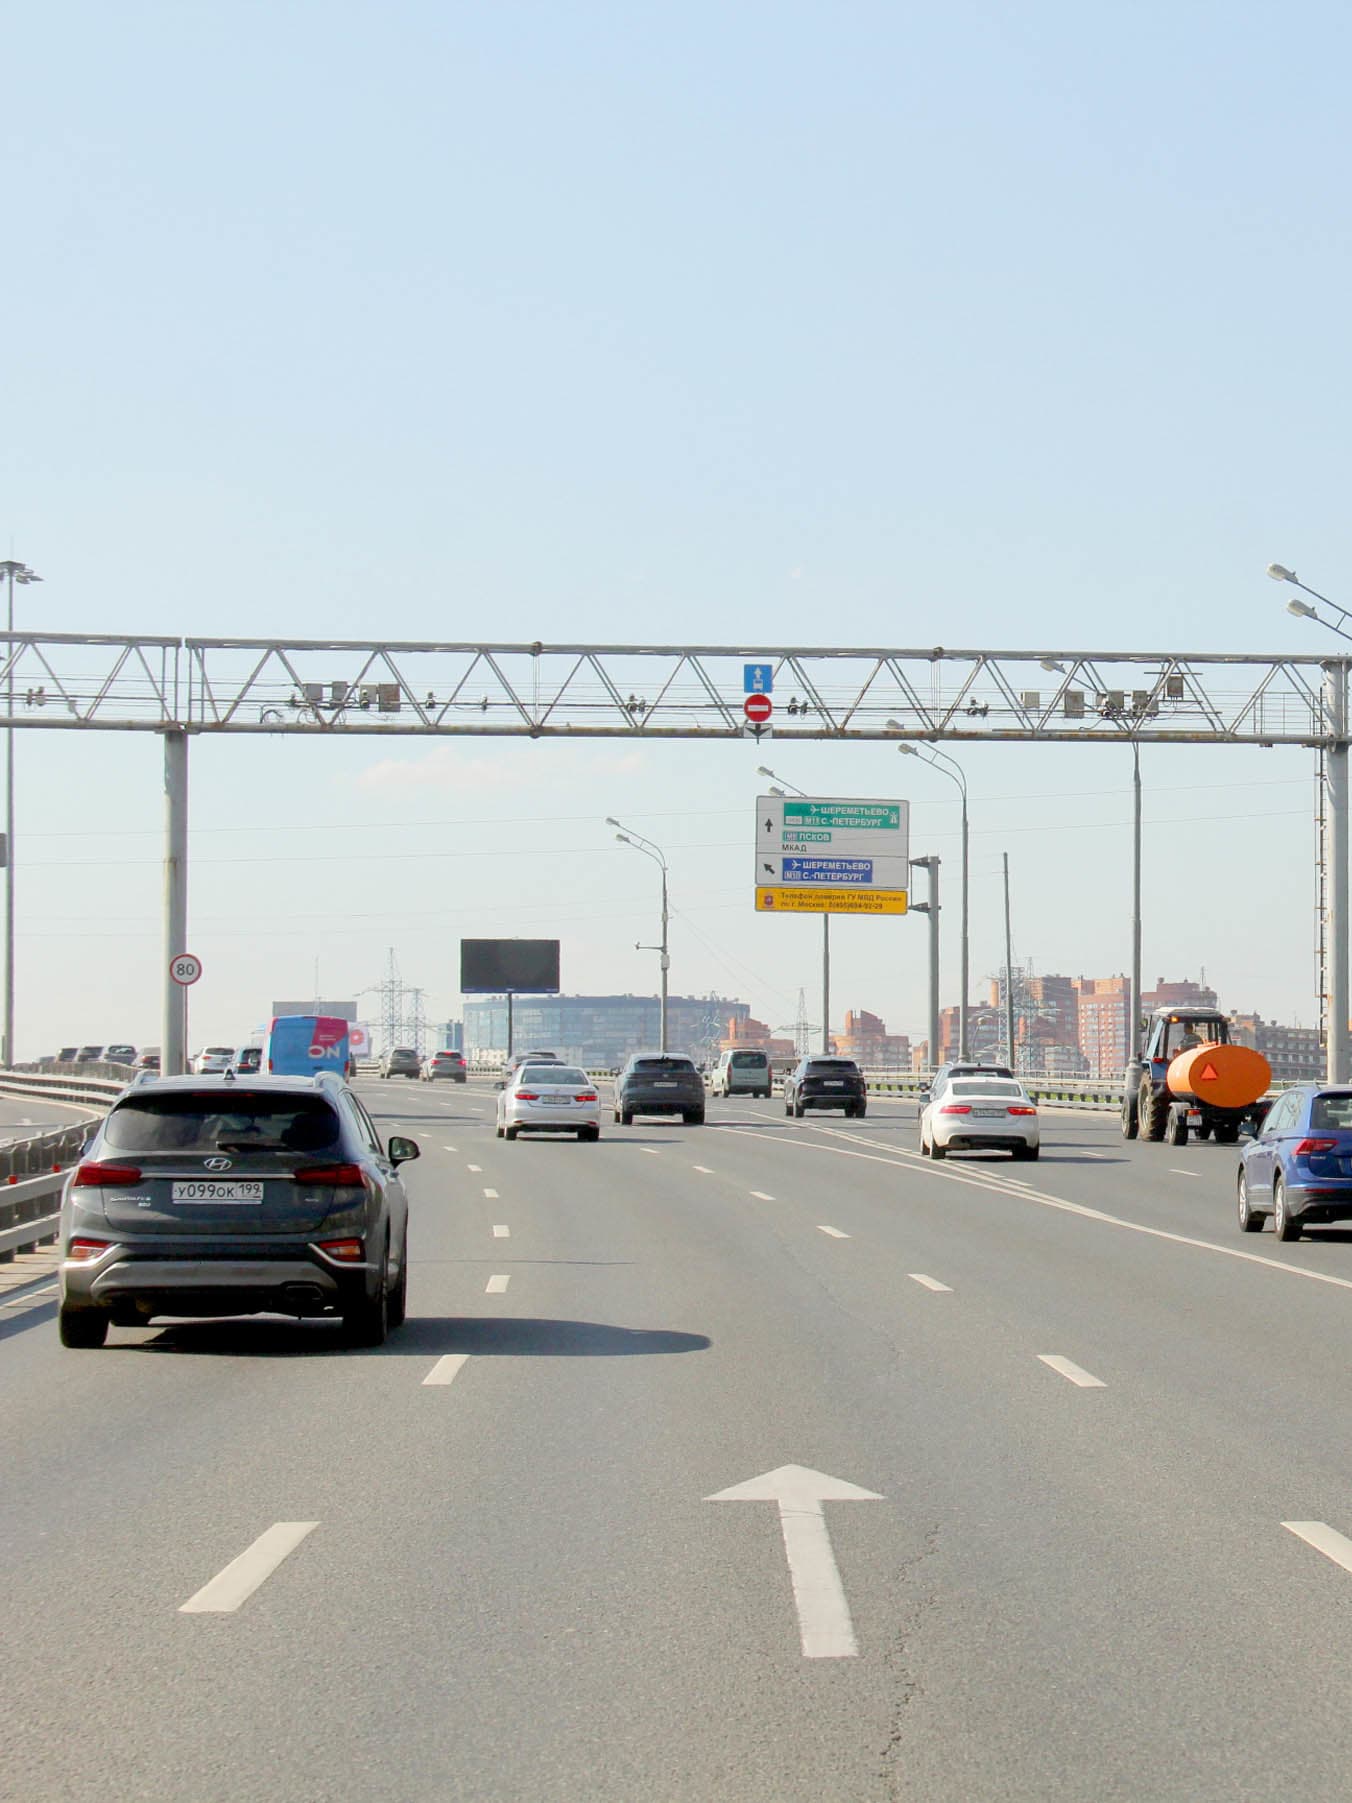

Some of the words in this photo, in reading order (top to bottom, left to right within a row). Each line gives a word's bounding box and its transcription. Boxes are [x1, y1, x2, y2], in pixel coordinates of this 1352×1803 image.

[820, 807, 889, 816] ШЕРЕМЕТЬЕВО
[800, 832, 830, 841] ПСКОВ
[782, 844, 807, 852] МКАД
[802, 861, 871, 871] ШЕРЕМЕТЬЕВО
[176, 963, 194, 976] 80
[308, 1045, 339, 1058] ON
[239, 1183, 260, 1194] 199
